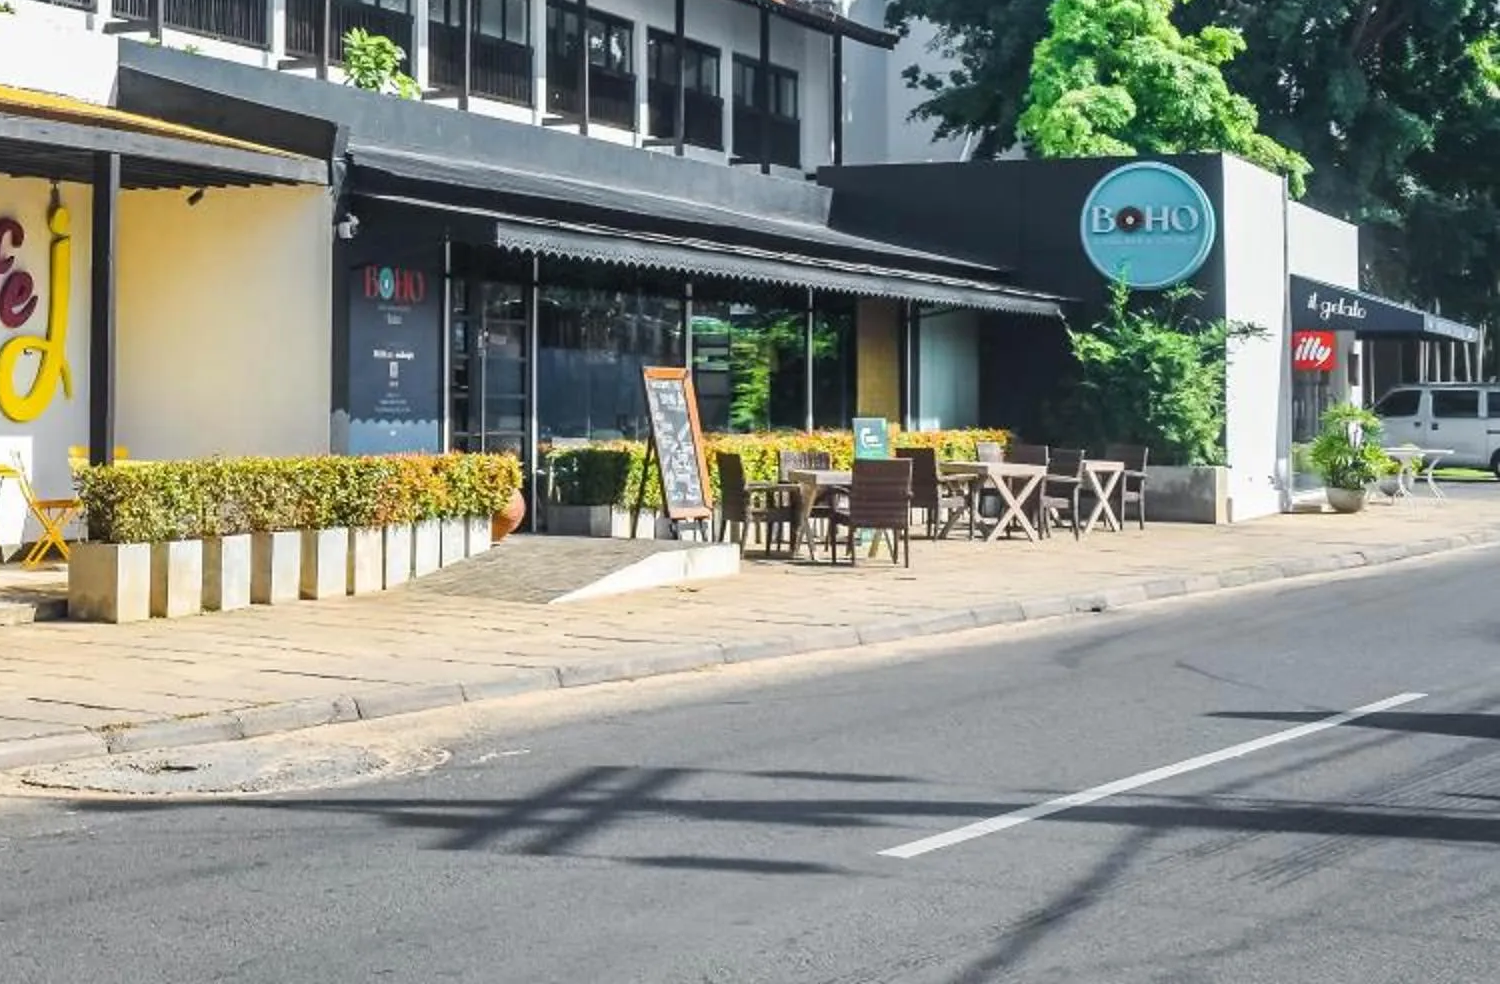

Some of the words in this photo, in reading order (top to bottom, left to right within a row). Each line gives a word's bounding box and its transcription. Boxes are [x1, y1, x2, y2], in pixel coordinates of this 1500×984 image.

[1092, 204, 1199, 233] BOHO
[363, 265, 425, 303] BOHO
[1320, 297, 1367, 320] gelato
[1295, 337, 1331, 367] illy
